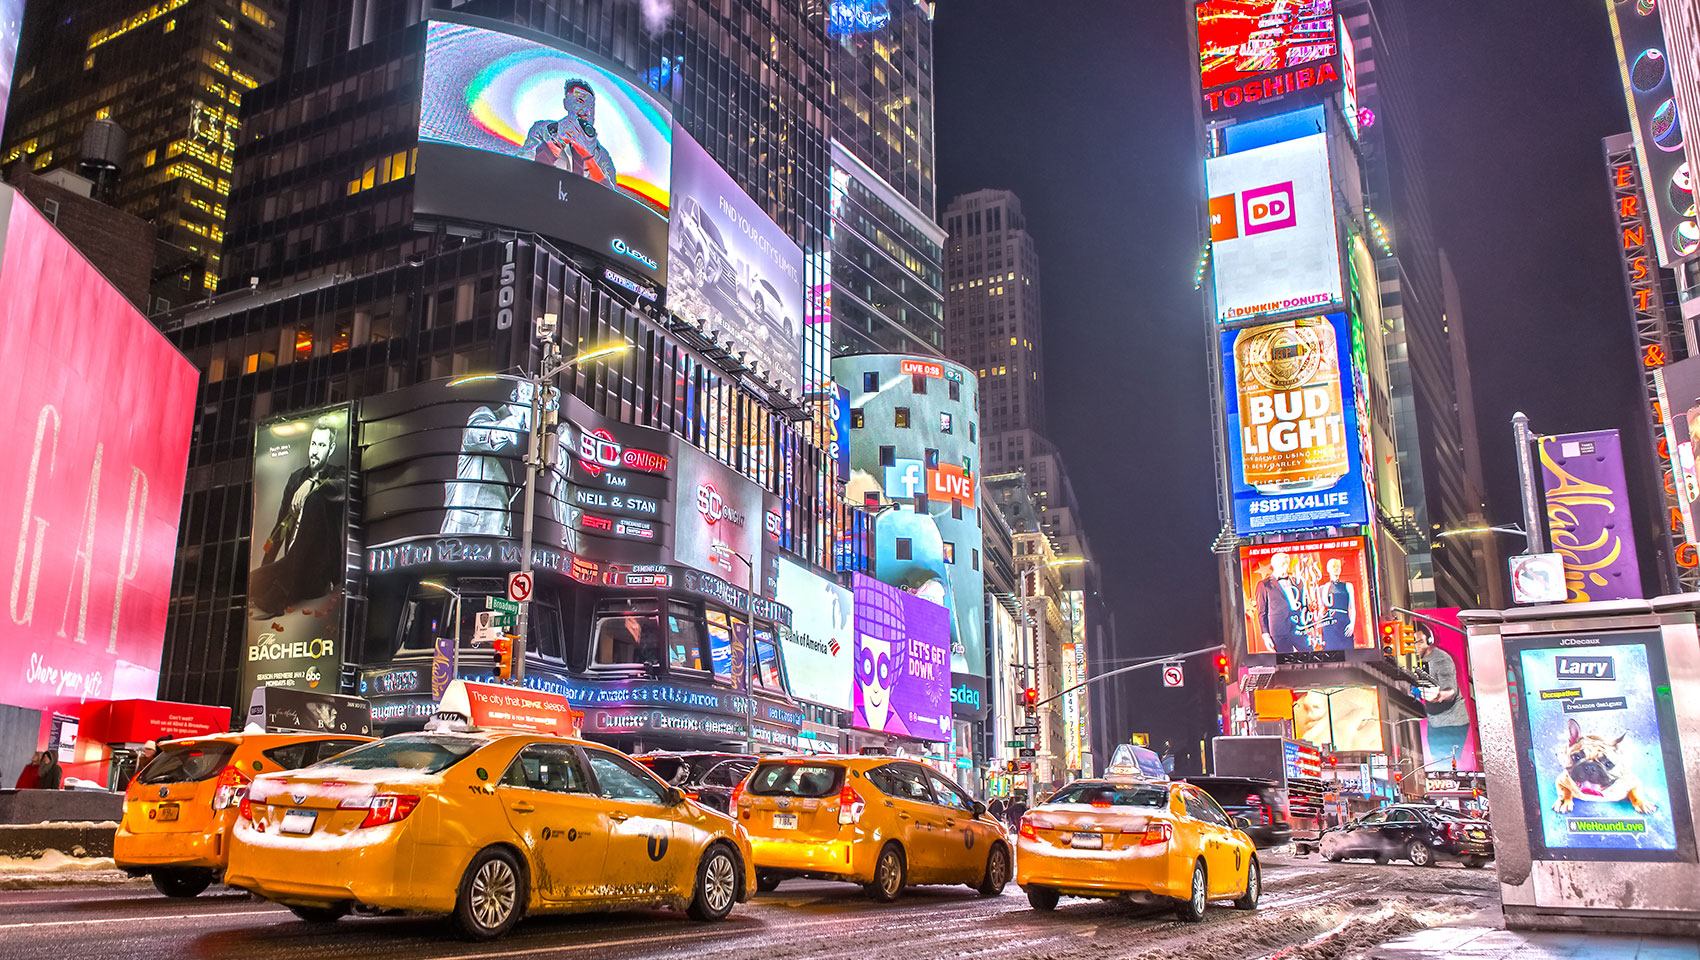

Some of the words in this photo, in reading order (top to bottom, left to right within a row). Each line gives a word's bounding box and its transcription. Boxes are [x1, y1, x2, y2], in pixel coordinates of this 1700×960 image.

[1204, 62, 1338, 112] TOSHIBA
[719, 195, 737, 222] FIND
[738, 213, 758, 245] YOUR
[1252, 200, 1285, 219] DD
[1616, 165, 1652, 311] ERNST
[625, 246, 658, 270] LEXUS
[497, 241, 515, 330] 1500
[1236, 301, 1282, 316] DUNKIN'
[1283, 293, 1329, 308] DONUTS
[904, 363, 923, 373] LIVE
[1250, 388, 1330, 426] BUD
[1243, 415, 1341, 455] LIGHT
[580, 432, 621, 467] SC
[624, 451, 669, 472] @NIGHT
[1285, 450, 1311, 459] USING
[605, 473, 626, 486] 1AM
[901, 465, 919, 497] f
[935, 472, 970, 498] LIVE
[577, 491, 607, 506] NEIL
[611, 496, 622, 508] &
[627, 498, 656, 513] STAN
[696, 485, 723, 520] SC
[1249, 492, 1349, 514] #SBTIX4LIFE
[10, 404, 149, 655] GAP
[582, 514, 612, 531] ESPN
[493, 599, 518, 614] Broadway
[1287, 583, 1334, 612] BANG
[495, 618, 500, 626] W
[503, 616, 510, 625] 44
[248, 638, 334, 661] BACHELOR
[258, 632, 276, 647] The
[800, 633, 806, 647] of
[806, 635, 827, 655] America
[908, 638, 930, 661] LET'S
[931, 645, 946, 666] GET
[1075, 643, 1084, 664] SOON
[26, 652, 58, 685] Share
[56, 668, 83, 697] your
[80, 671, 103, 704] gift
[274, 671, 293, 679] PREMIERE
[306, 671, 320, 681] abc
[908, 657, 935, 681] DOWN.
[1559, 659, 1609, 678] Larry
[471, 690, 488, 703] The
[489, 693, 503, 706] city
[504, 695, 520, 706] that
[543, 701, 568, 712] sleeps.
[949, 684, 980, 711] sdaq
[1541, 690, 1581, 699] Occupation:
[188, 722, 210, 730] Broadway
[1570, 821, 1644, 831] #WeHoundLove
